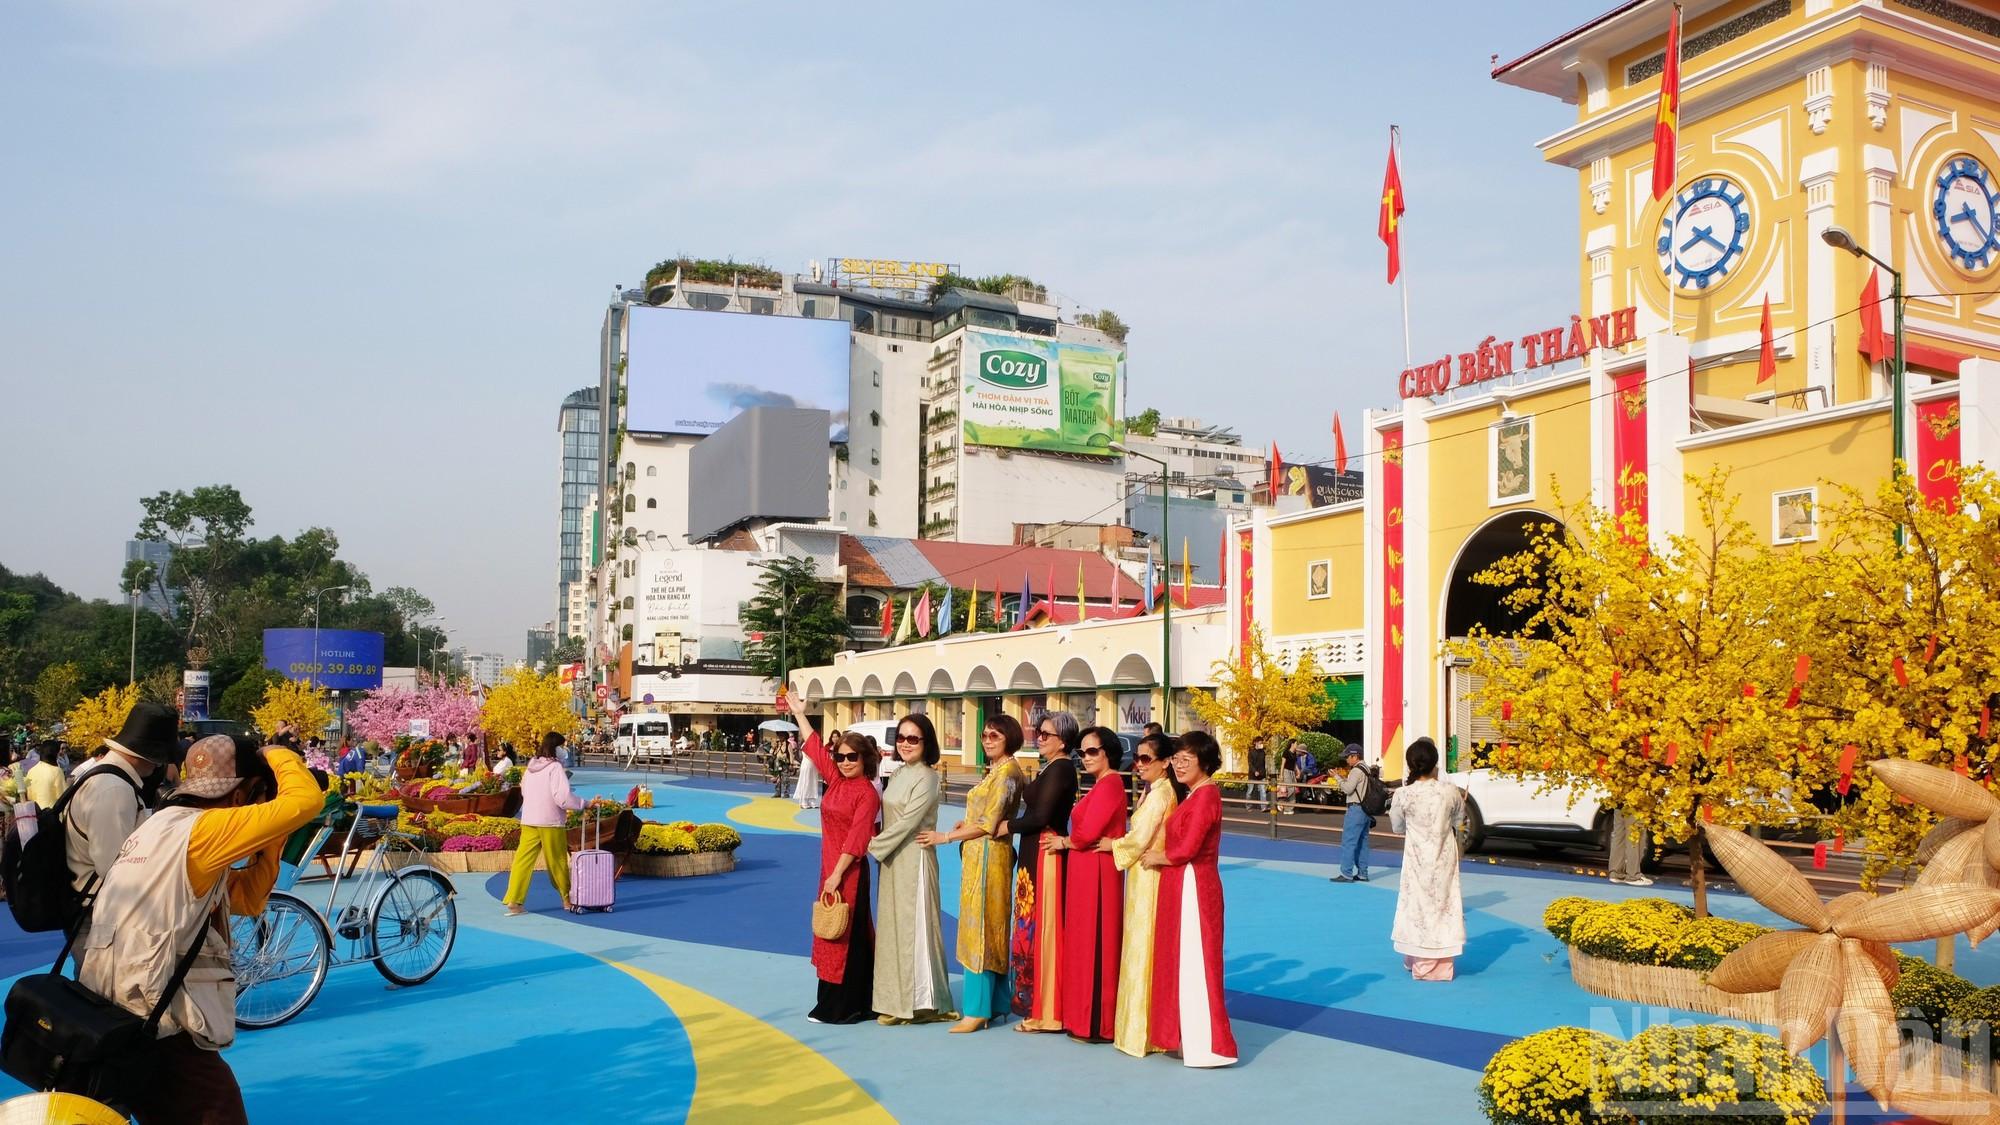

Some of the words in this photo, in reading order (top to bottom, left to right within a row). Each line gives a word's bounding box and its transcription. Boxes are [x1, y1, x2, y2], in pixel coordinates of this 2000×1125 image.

[842, 258, 948, 278] SILVERLAND
[1399, 354, 1452, 399] CHỢ
[1458, 335, 1514, 386] BẾN
[1521, 306, 1638, 369] THÀNH
[986, 354, 1041, 383] Cozy
[977, 392, 1001, 401] THƠM
[1064, 389, 1080, 406] BỘT
[972, 401, 987, 409] HÀI
[989, 403, 1007, 412] HÒA
[1009, 405, 1029, 414] NHỊP
[1031, 406, 1054, 416] SỐNG
[1064, 408, 1097, 425] MATCHA
[654, 572, 683, 584] Legend
[320, 650, 356, 658] HOTLINE
[290, 662, 377, 676] 0969.39.89.89
[1120, 698, 1147, 725] Vikki
